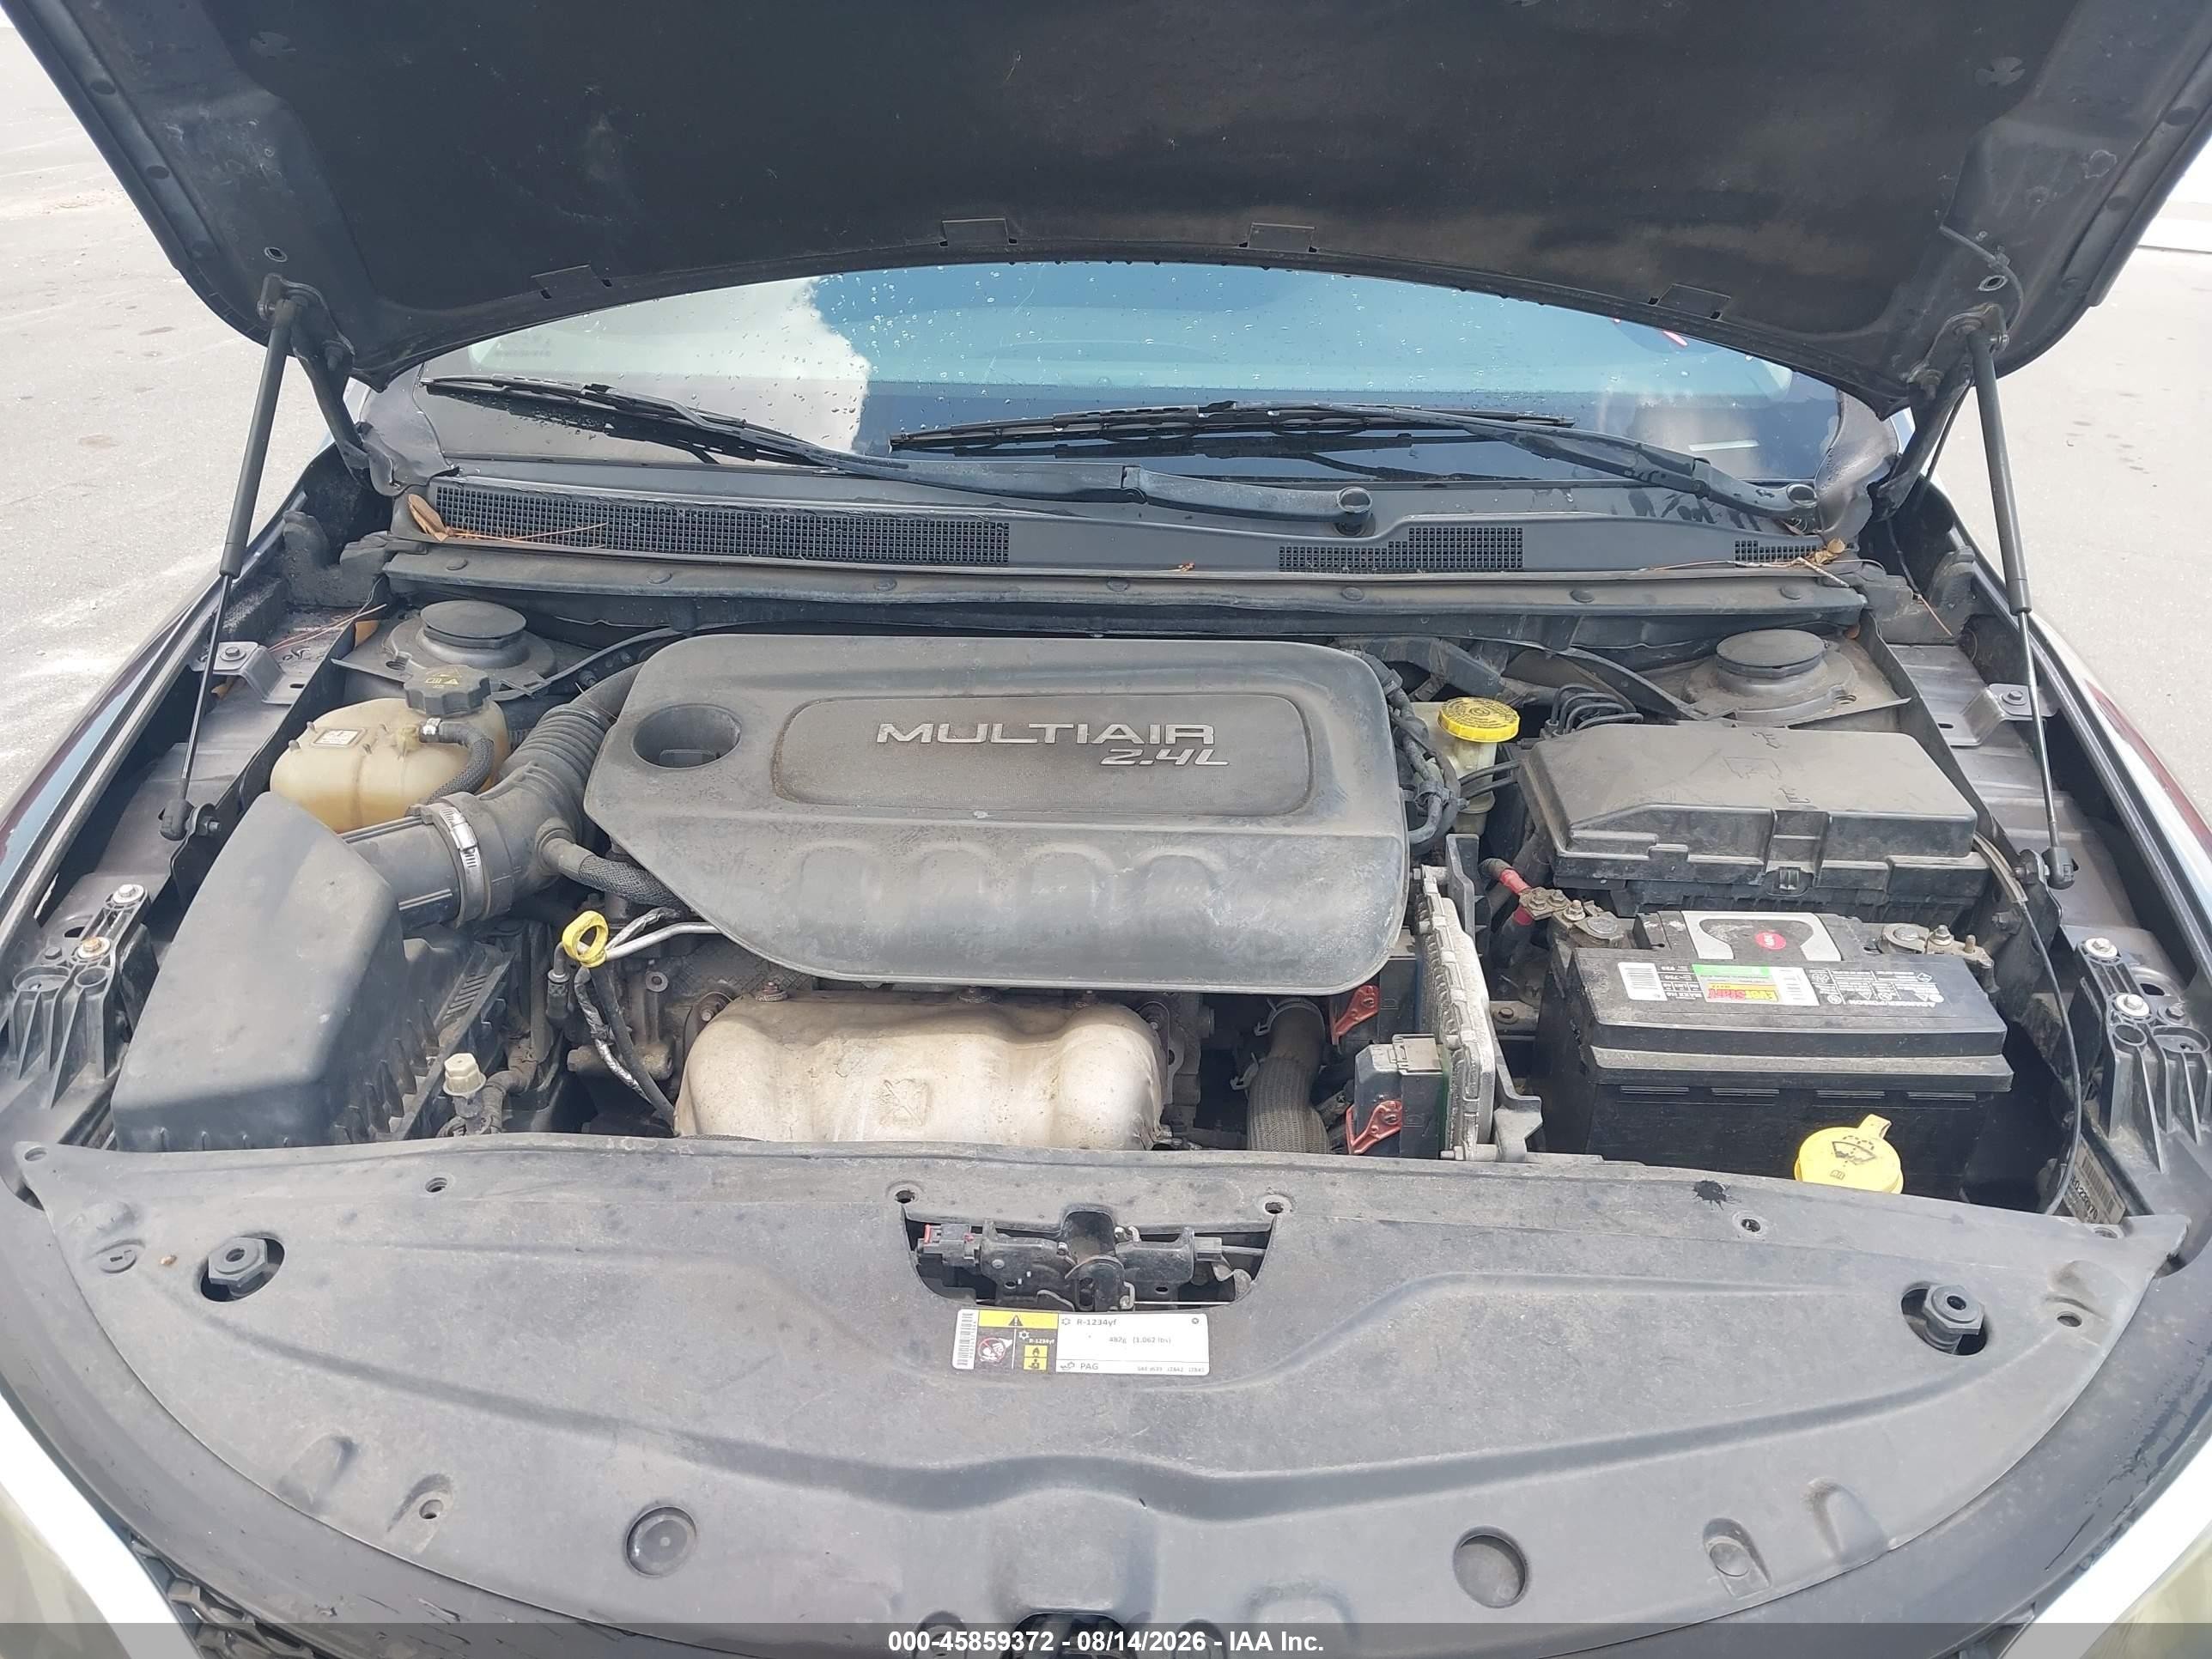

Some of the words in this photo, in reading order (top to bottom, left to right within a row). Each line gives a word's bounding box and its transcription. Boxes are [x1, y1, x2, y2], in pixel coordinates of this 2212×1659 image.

[876, 723, 1215, 744] MULTIAIR
[1100, 748, 1230, 766] 2.4L
[1077, 1318, 1117, 1328] R-1234yf
